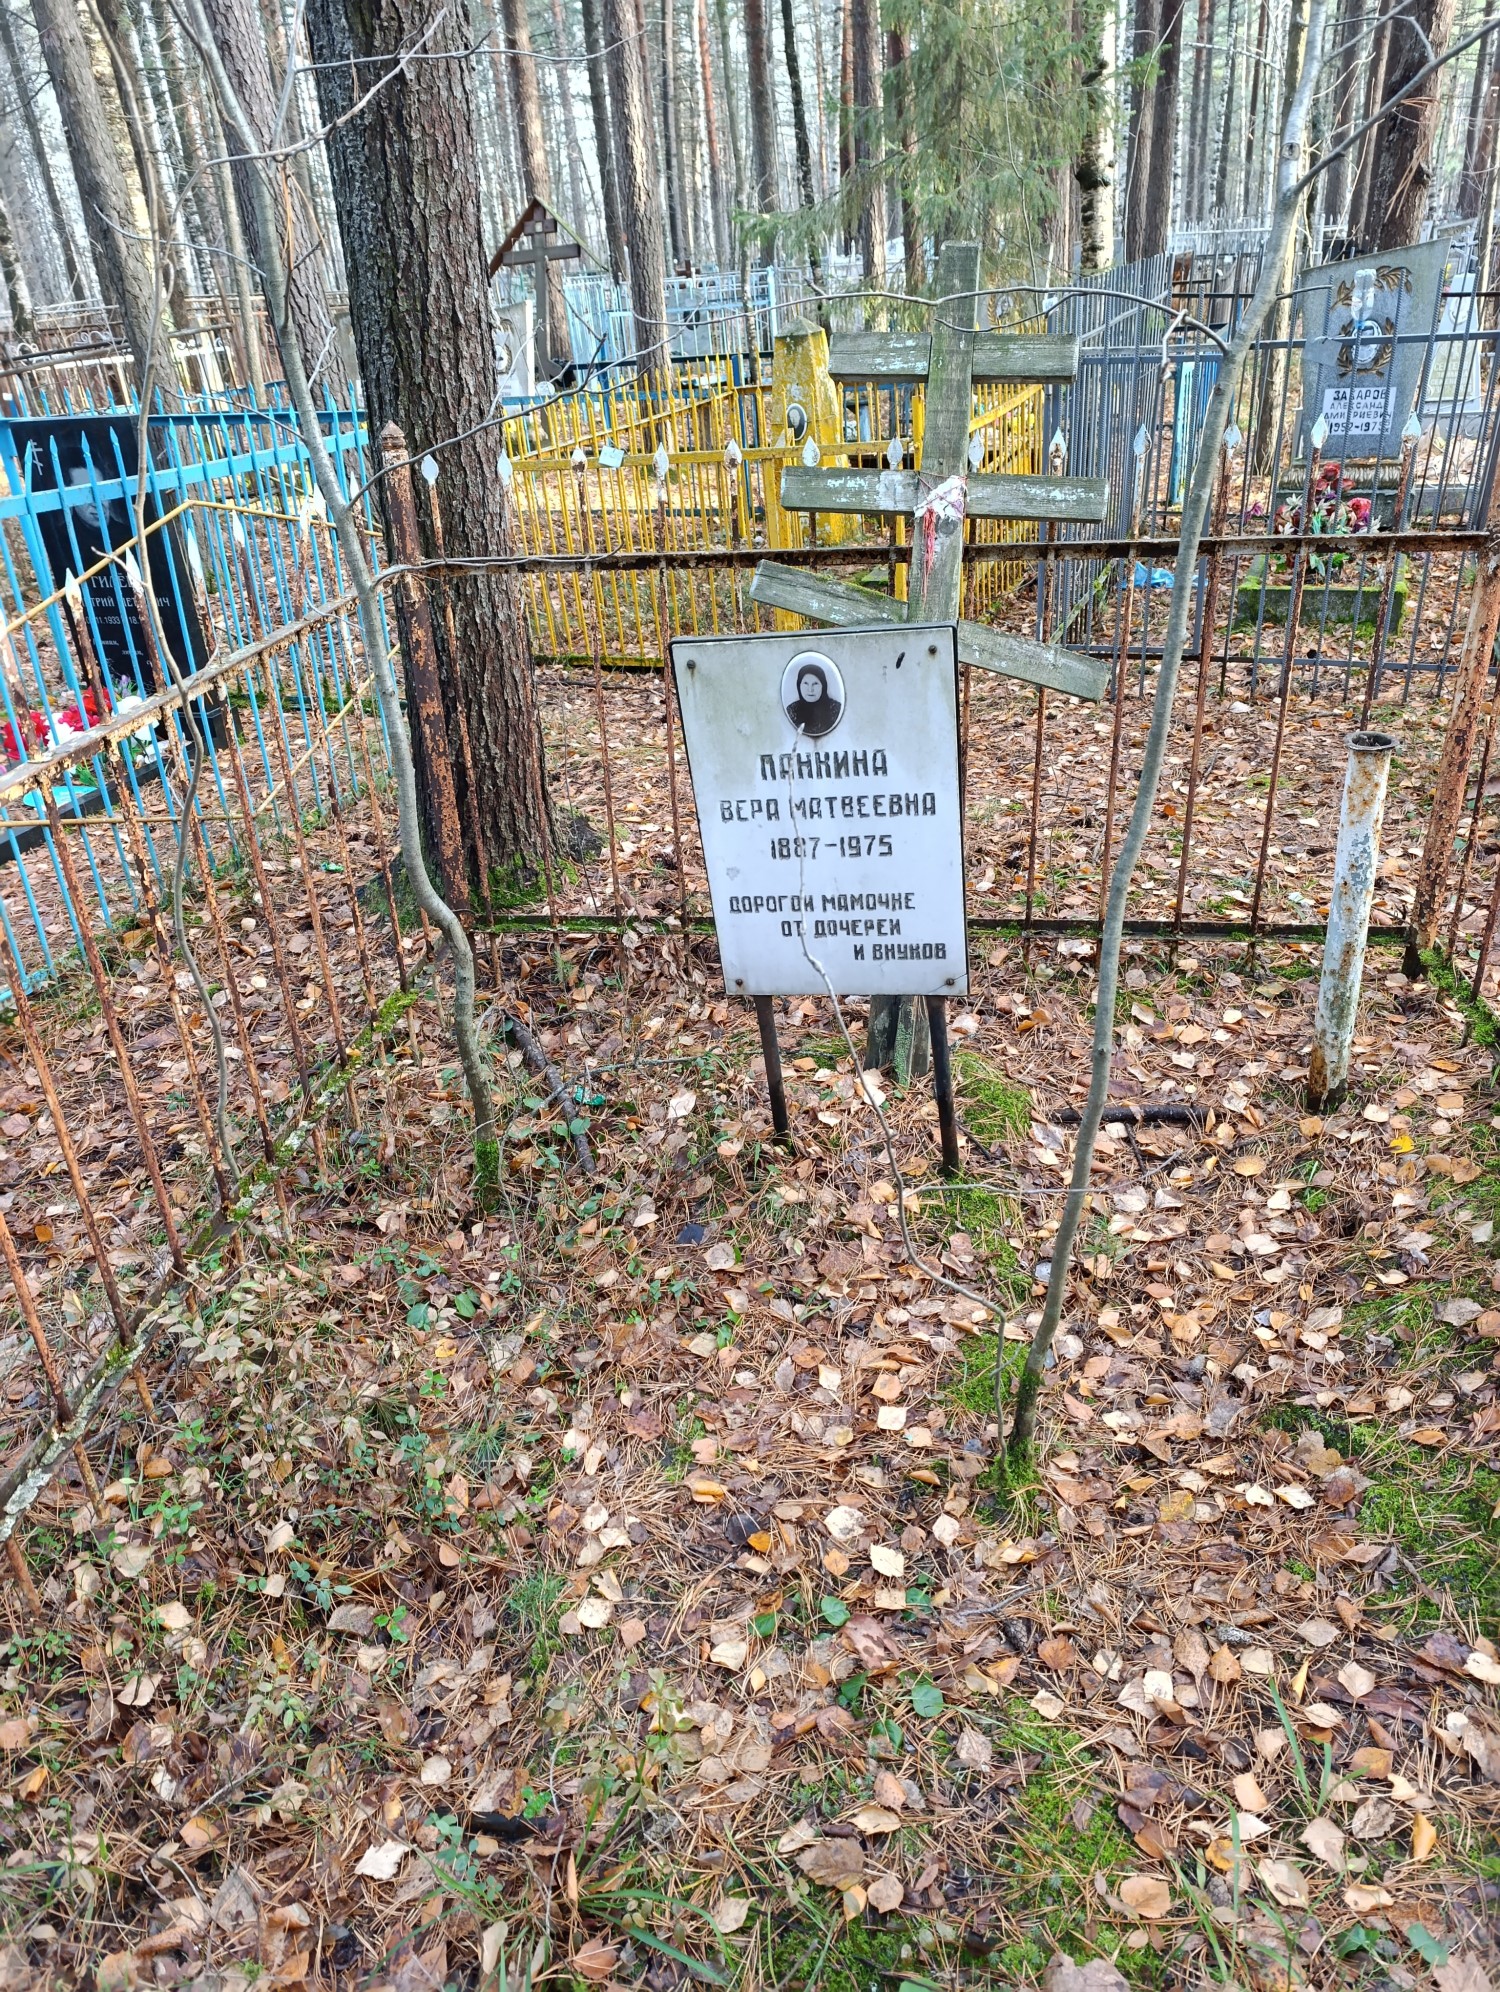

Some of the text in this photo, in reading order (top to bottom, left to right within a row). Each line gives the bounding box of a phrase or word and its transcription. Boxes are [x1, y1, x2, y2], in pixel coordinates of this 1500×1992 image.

[1333, 389, 1388, 401] ЗААРОВ
[760, 749, 888, 780] ПАНКИНА
[720, 792, 936, 823] ВЕРА МАТВЕЕВНА
[771, 834, 893, 859] 1887-1975
[781, 920, 803, 937] ОТ
[853, 942, 947, 960] И ВНУКОВ
